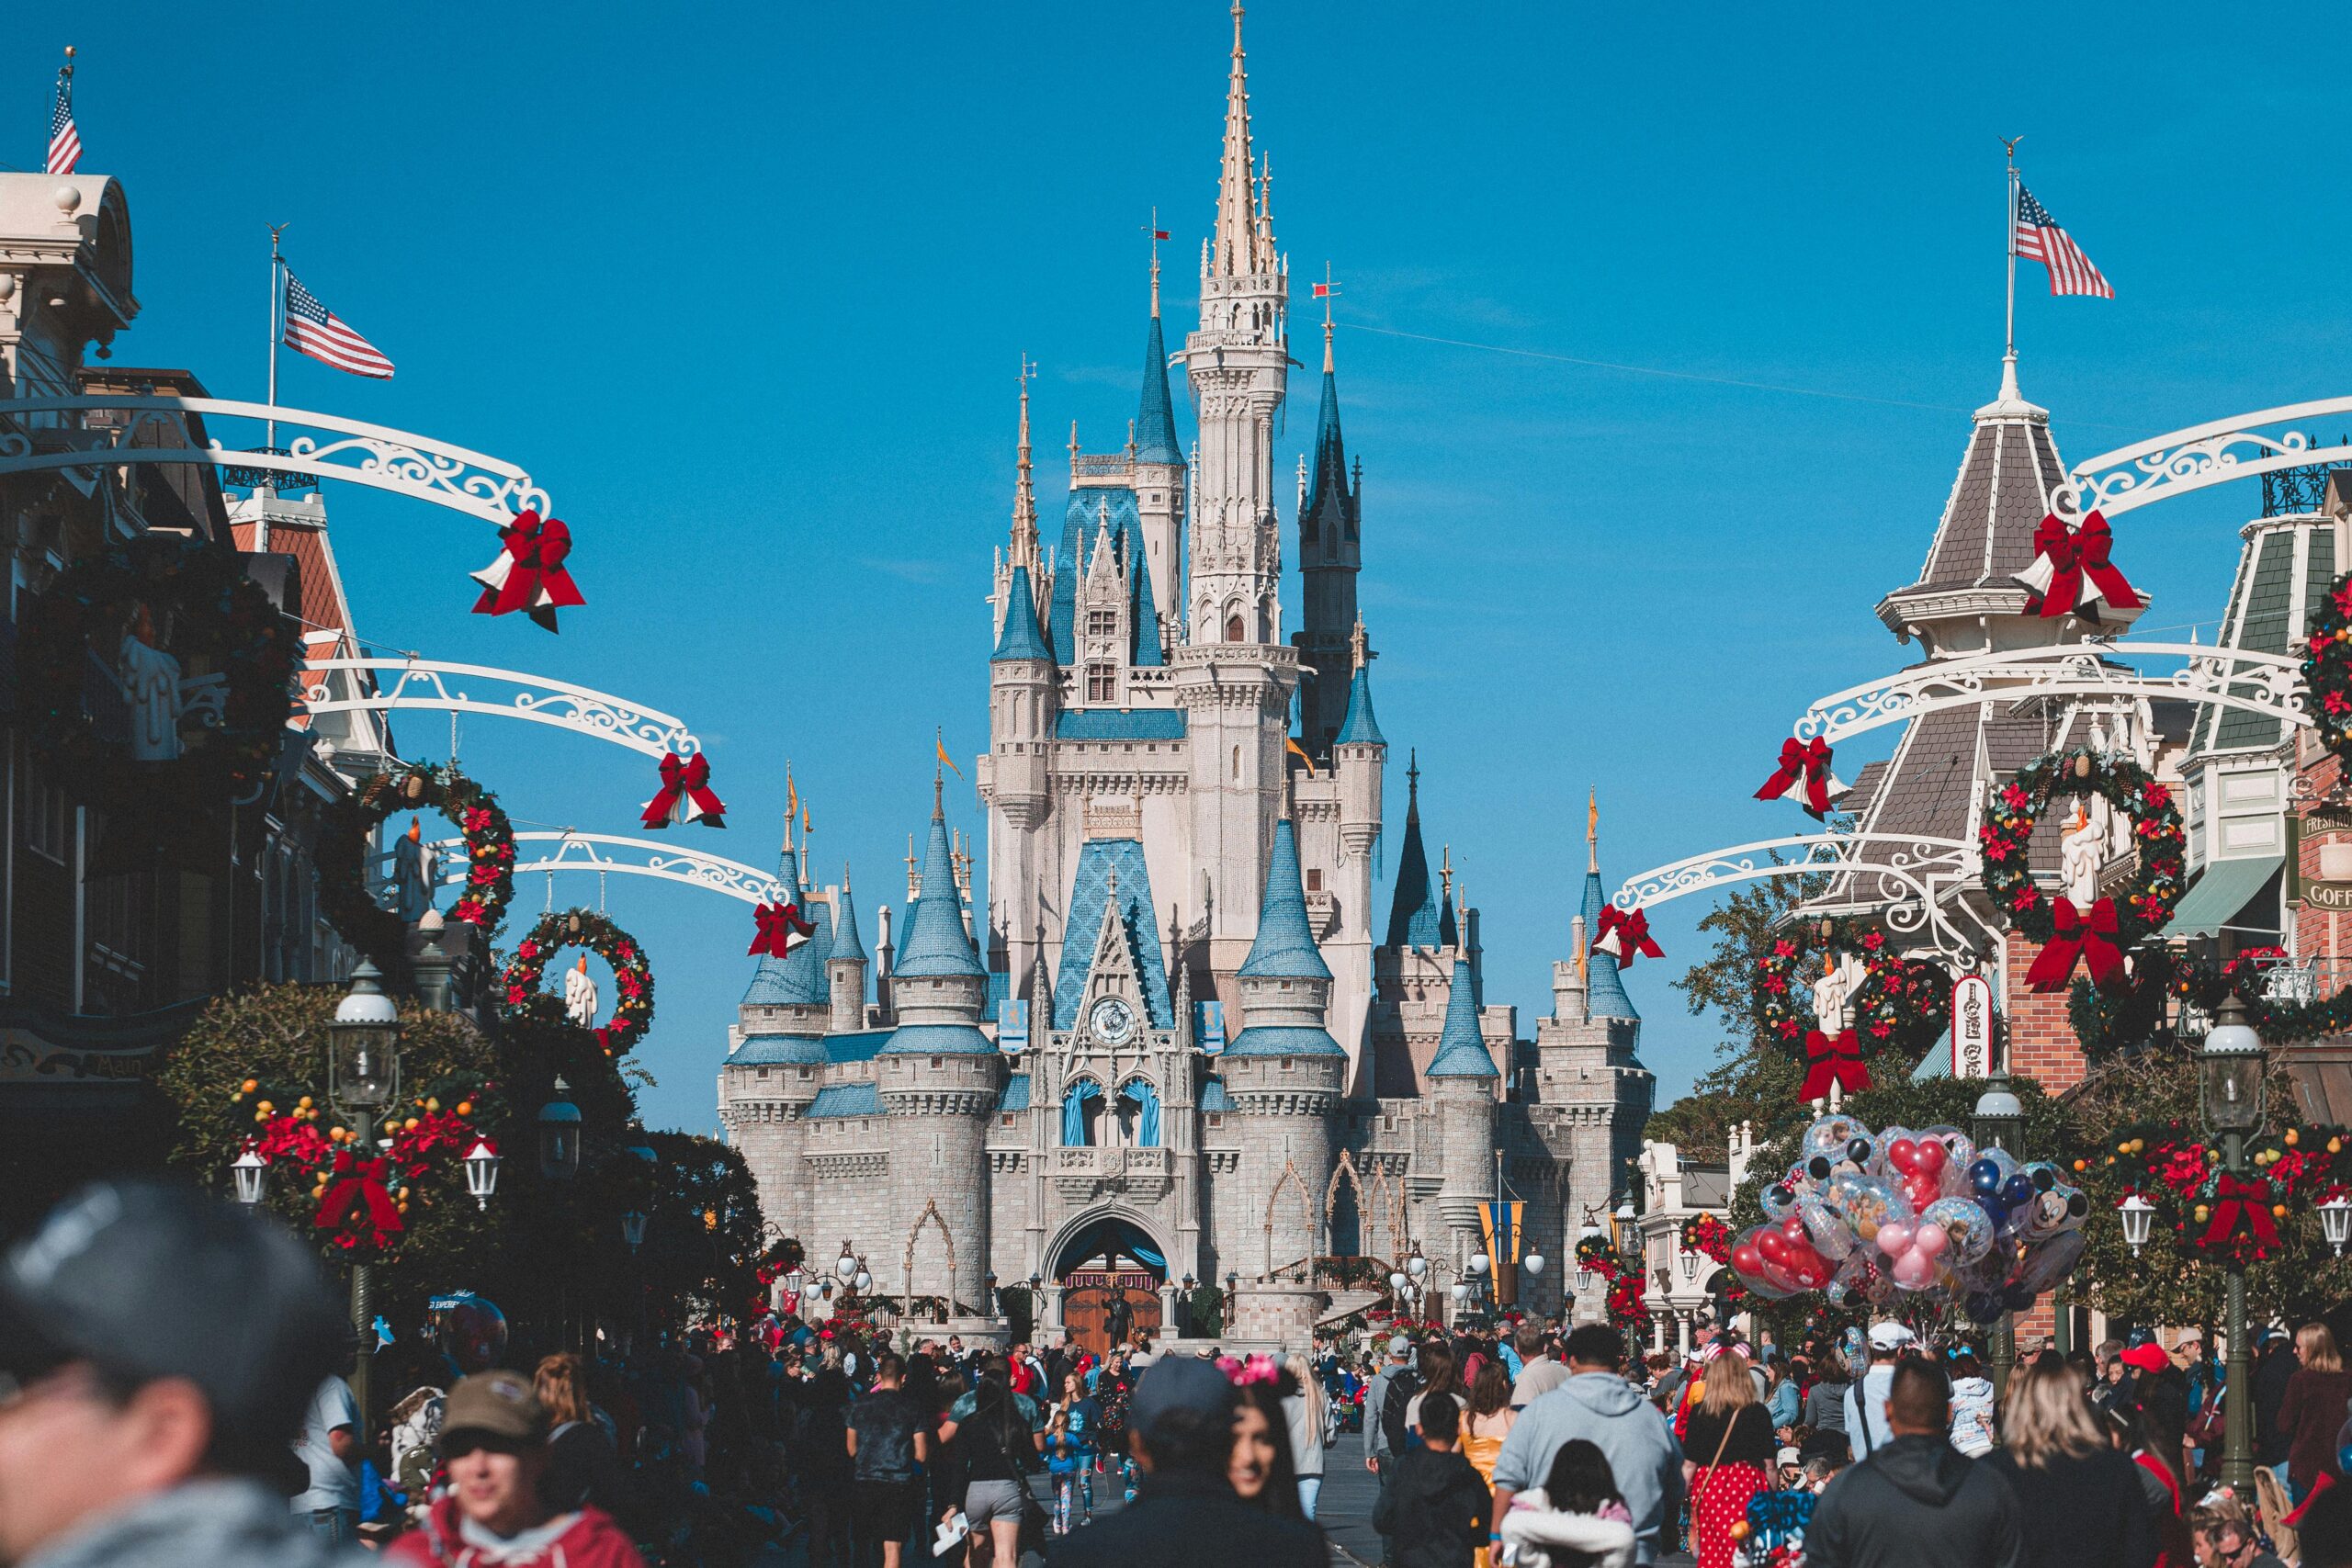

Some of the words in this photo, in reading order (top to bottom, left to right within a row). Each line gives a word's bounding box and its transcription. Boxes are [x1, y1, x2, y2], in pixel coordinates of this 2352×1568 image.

[2306, 814, 2335, 834] FRESH
[2336, 813, 2352, 828] RO
[1963, 983, 1982, 1039] ICE
[96, 1055, 142, 1077] Main
